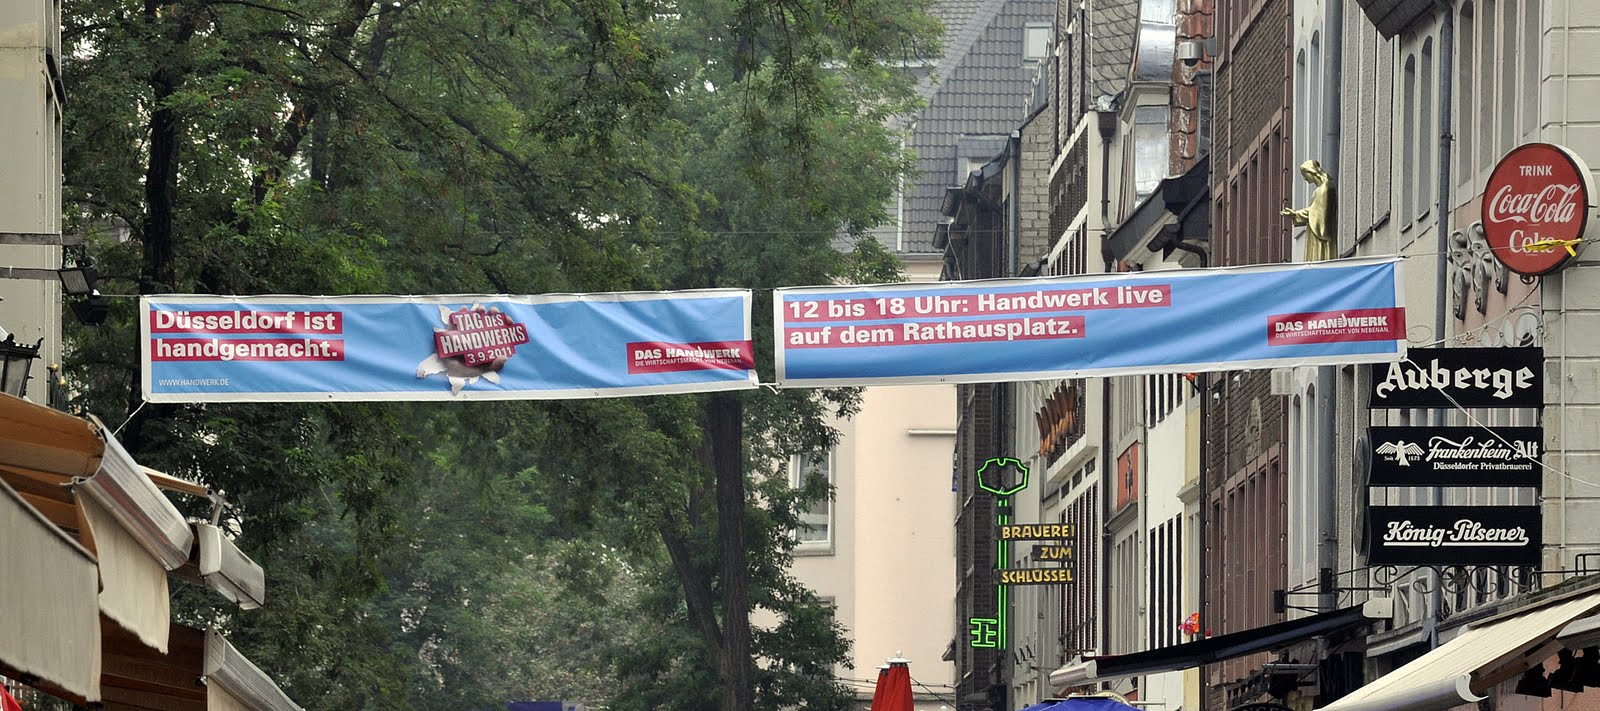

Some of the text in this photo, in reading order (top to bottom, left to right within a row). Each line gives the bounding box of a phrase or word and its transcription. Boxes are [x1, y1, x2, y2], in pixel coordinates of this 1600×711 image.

[1519, 165, 1553, 176] TRINK
[1489, 183, 1580, 223] Coca-Cola
[789, 285, 1163, 319] 12 bis 18 Uhr: Handwerk live
[156, 310, 336, 330] Düsseldorf ist
[455, 313, 504, 331] TAG DES
[1275, 313, 1387, 332] DAS HANDWERK
[440, 325, 526, 354] HANDWERKS
[789, 317, 1078, 345] auf dem Rathausplatz.
[1275, 331, 1285, 339] DIE
[156, 339, 338, 361] handgemacht.
[634, 346, 740, 360] DAS HANDWERK
[158, 378, 229, 386] WWW.HANDWERK.DE
[1376, 358, 1535, 399] Auberge
[1425, 436, 1539, 462] Frankenheim Alt
[1433, 462, 1532, 471] Düsseldorfer Privatbrauerei
[1002, 525, 1075, 539] BRAUEREI
[1383, 519, 1529, 547] König-Pilsener
[1040, 546, 1072, 559] ZUM
[1002, 569, 1073, 583] SCHLÜSSEL
